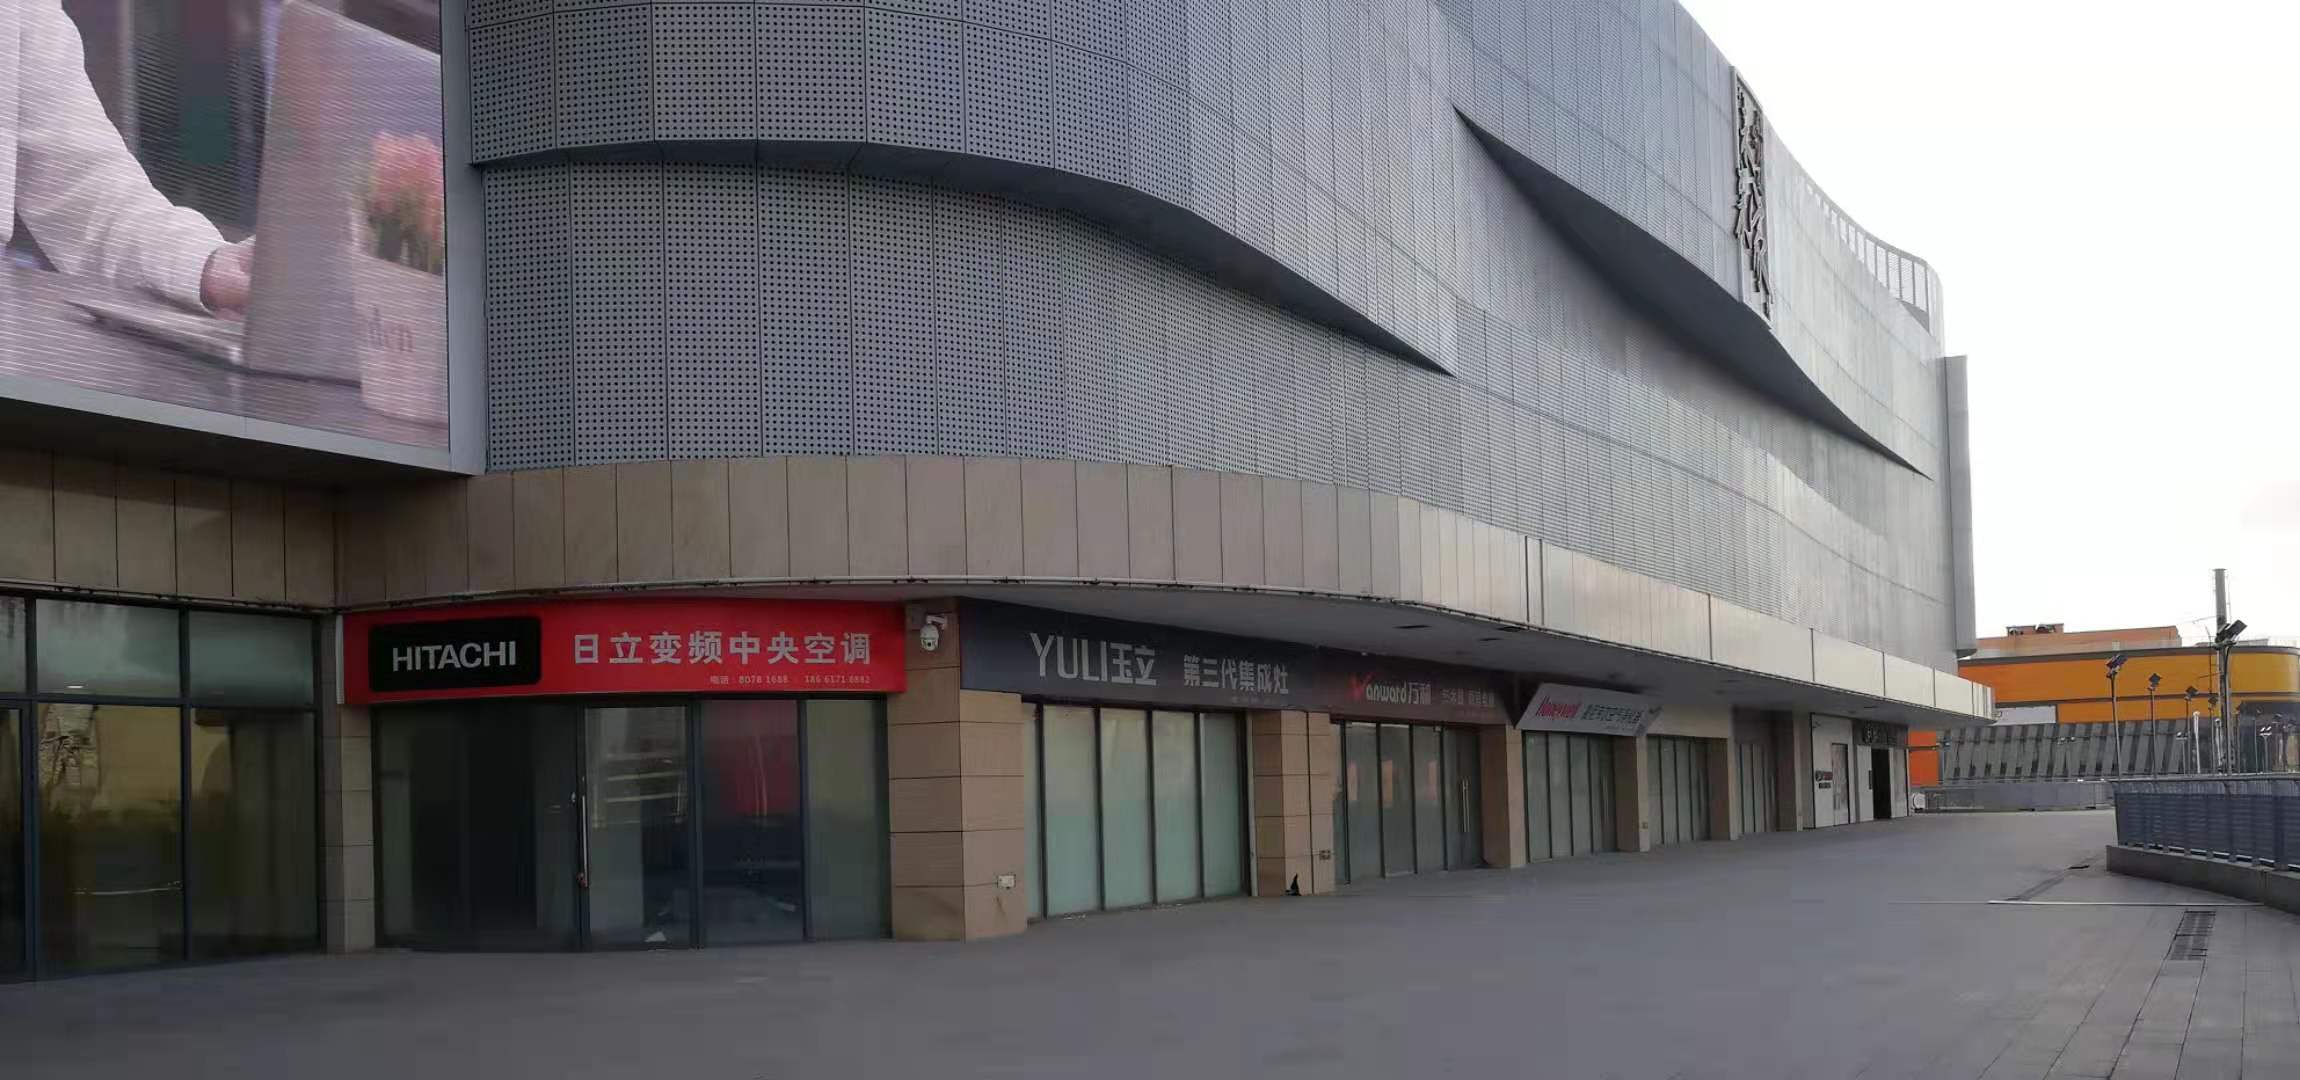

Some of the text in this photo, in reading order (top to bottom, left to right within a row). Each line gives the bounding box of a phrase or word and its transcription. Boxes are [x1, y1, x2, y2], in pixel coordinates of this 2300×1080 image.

[392, 640, 517, 672] HITACHI
[574, 631, 871, 666] 日立变频中央空调
[1183, 654, 1289, 695] 第三代集成灶
